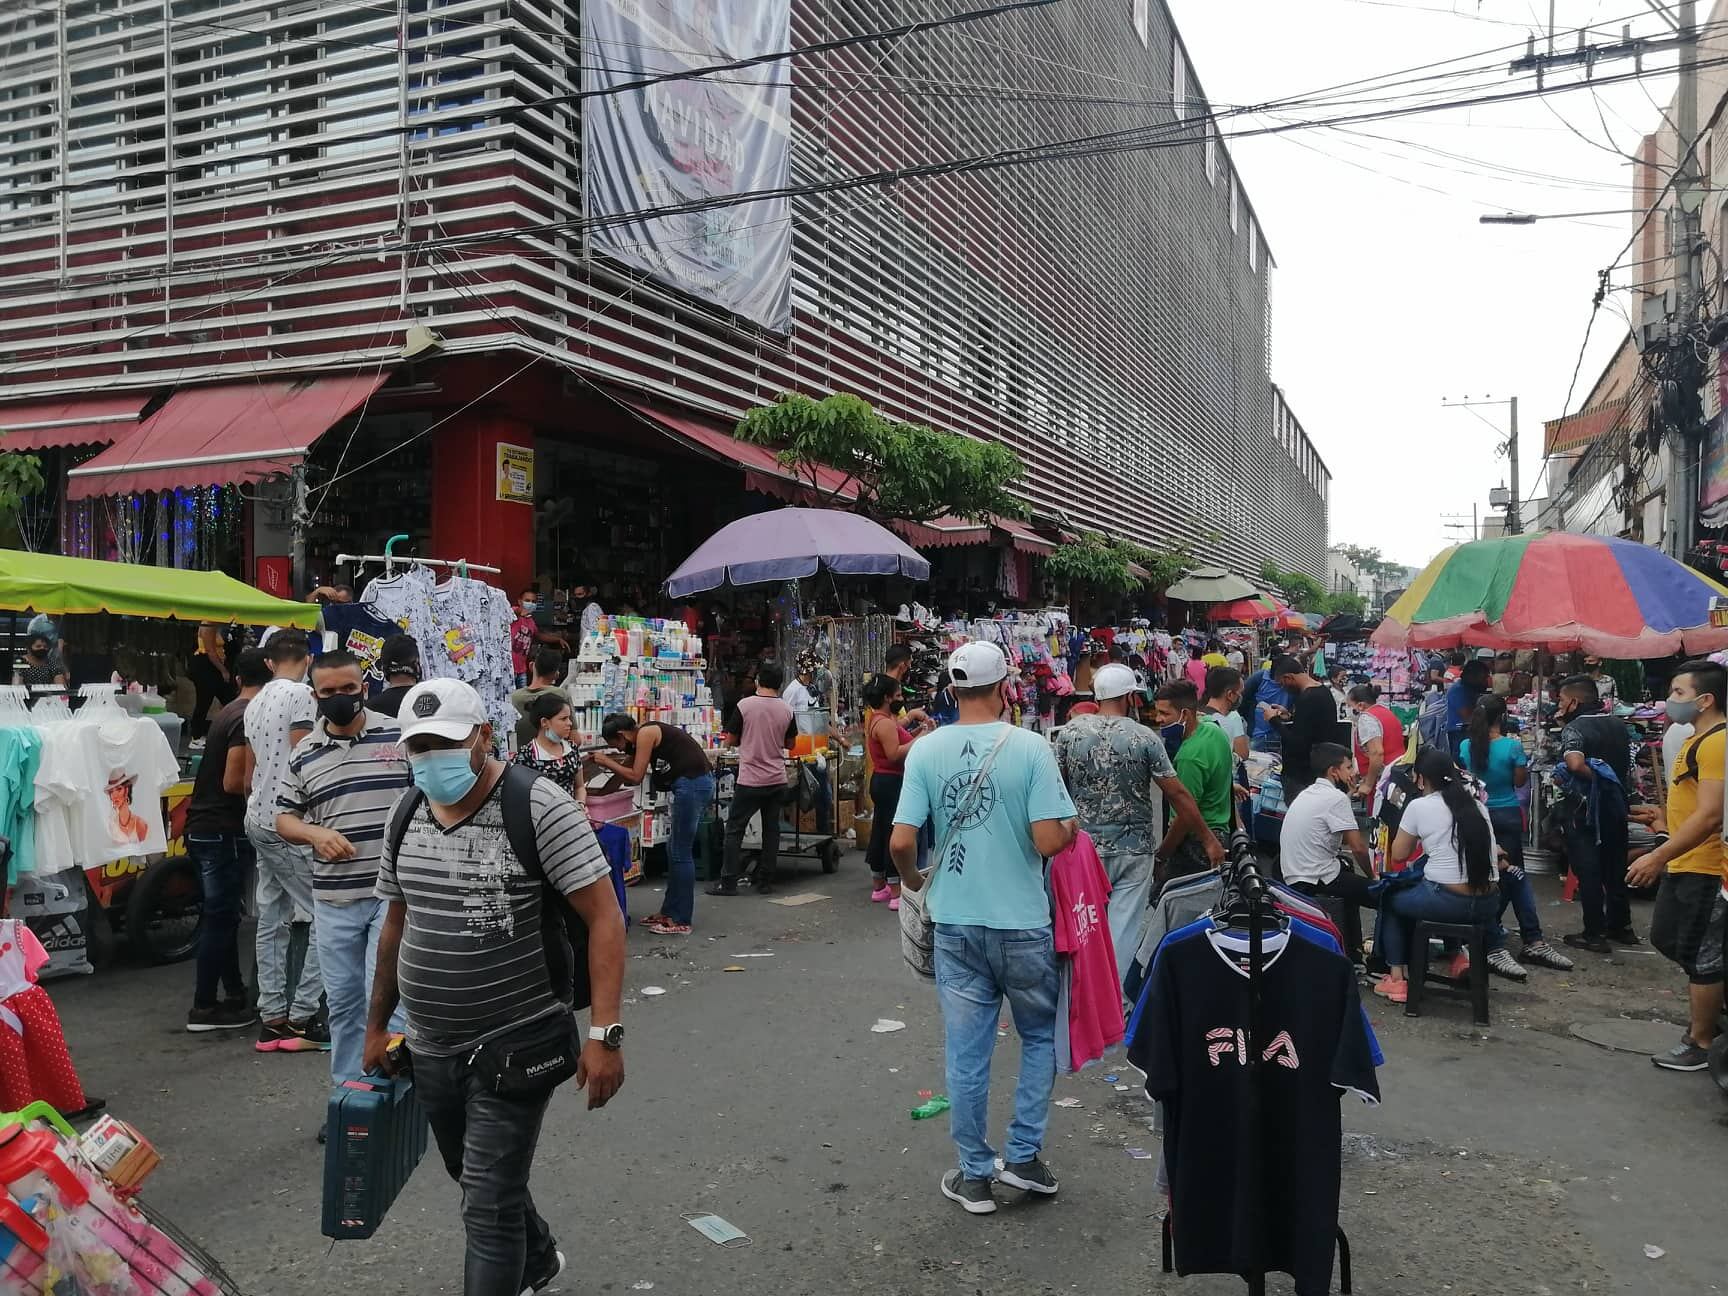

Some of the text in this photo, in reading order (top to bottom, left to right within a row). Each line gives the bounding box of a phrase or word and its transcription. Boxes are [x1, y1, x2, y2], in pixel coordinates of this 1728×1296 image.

[643, 84, 745, 172] NAVIDAD
[43, 935, 87, 949] adidas
[1204, 1027, 1301, 1070] FIA
[525, 1055, 564, 1075] MASISA
